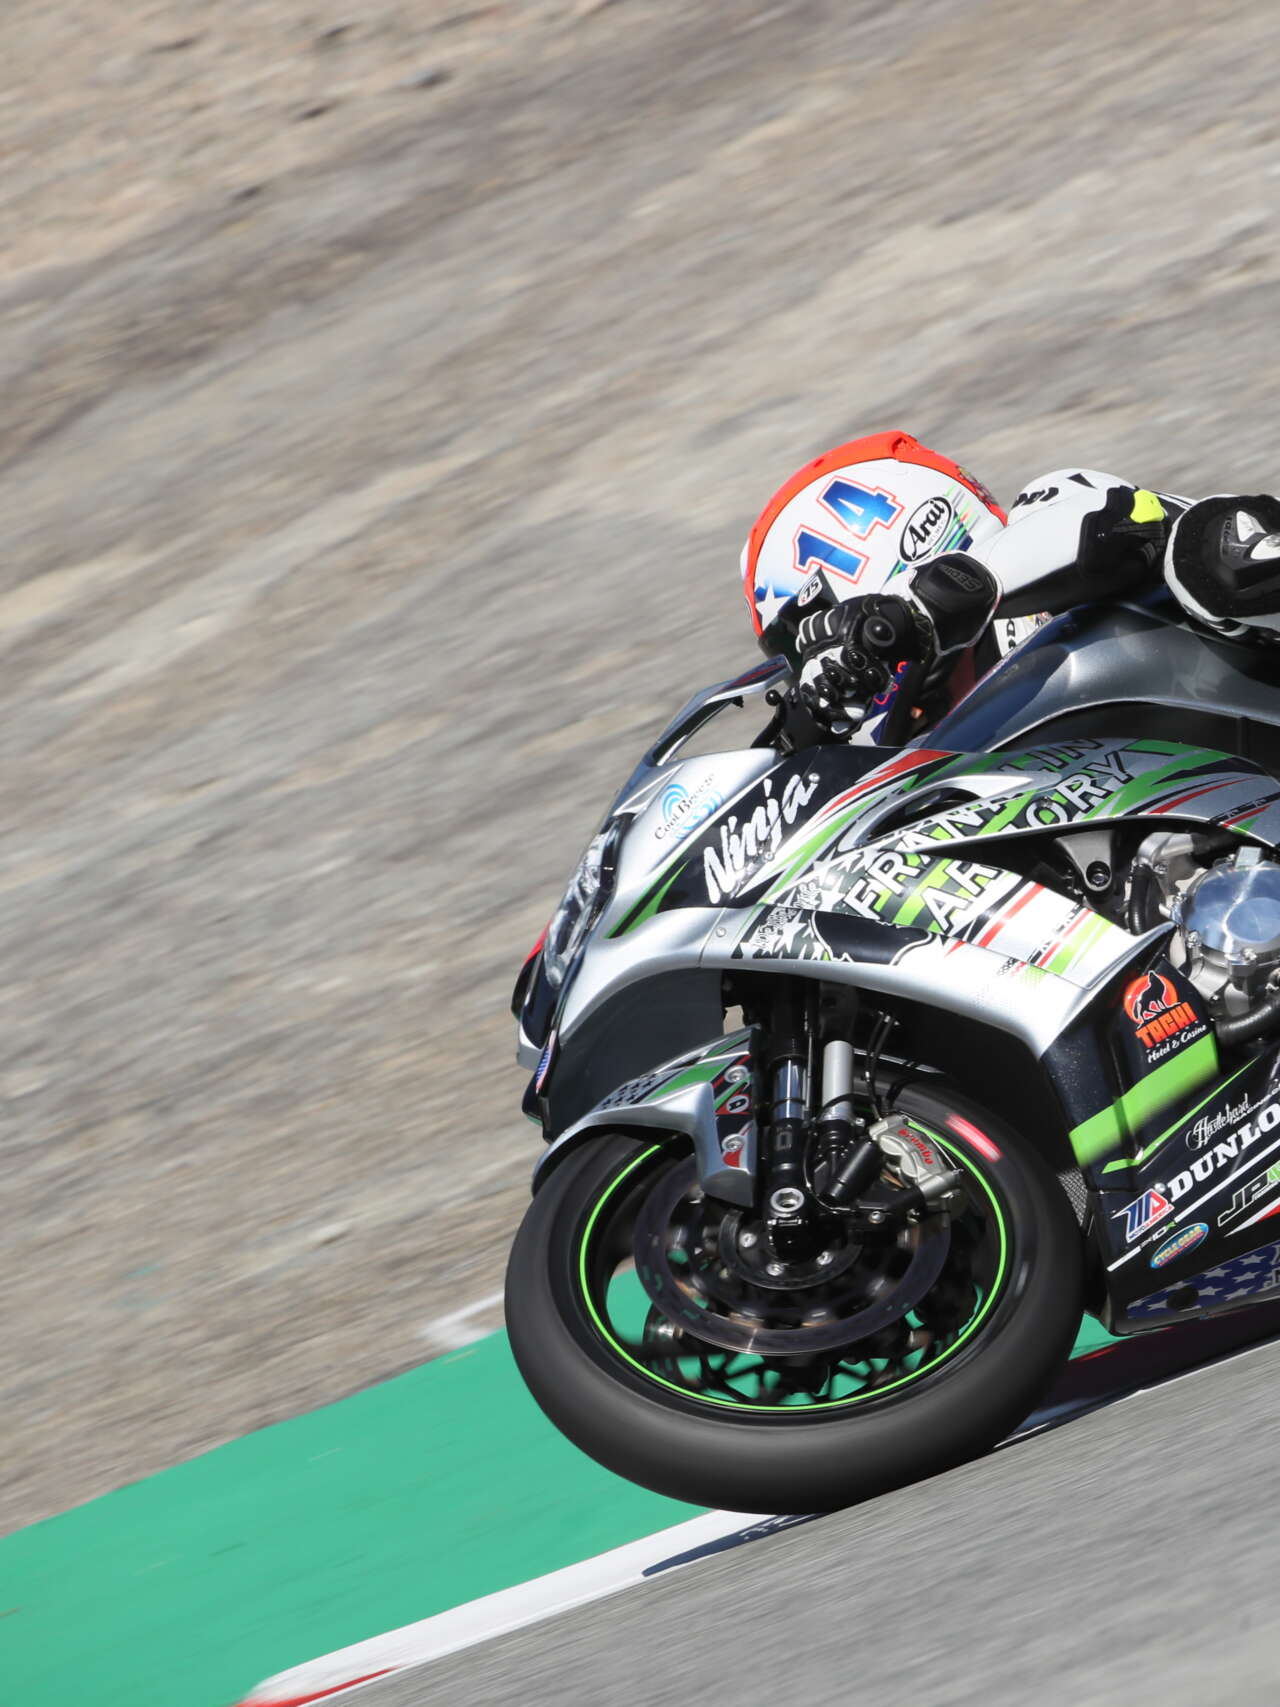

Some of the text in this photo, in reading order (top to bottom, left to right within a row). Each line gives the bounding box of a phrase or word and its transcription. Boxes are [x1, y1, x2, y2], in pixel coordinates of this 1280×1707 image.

[792, 475, 905, 585] 14
[911, 500, 946, 560] Arai
[703, 773, 820, 904] Ninja
[920, 751, 1132, 931] ARORY
[1148, 1042, 1170, 1063] Hotel
[1180, 1024, 1207, 1044] Casino
